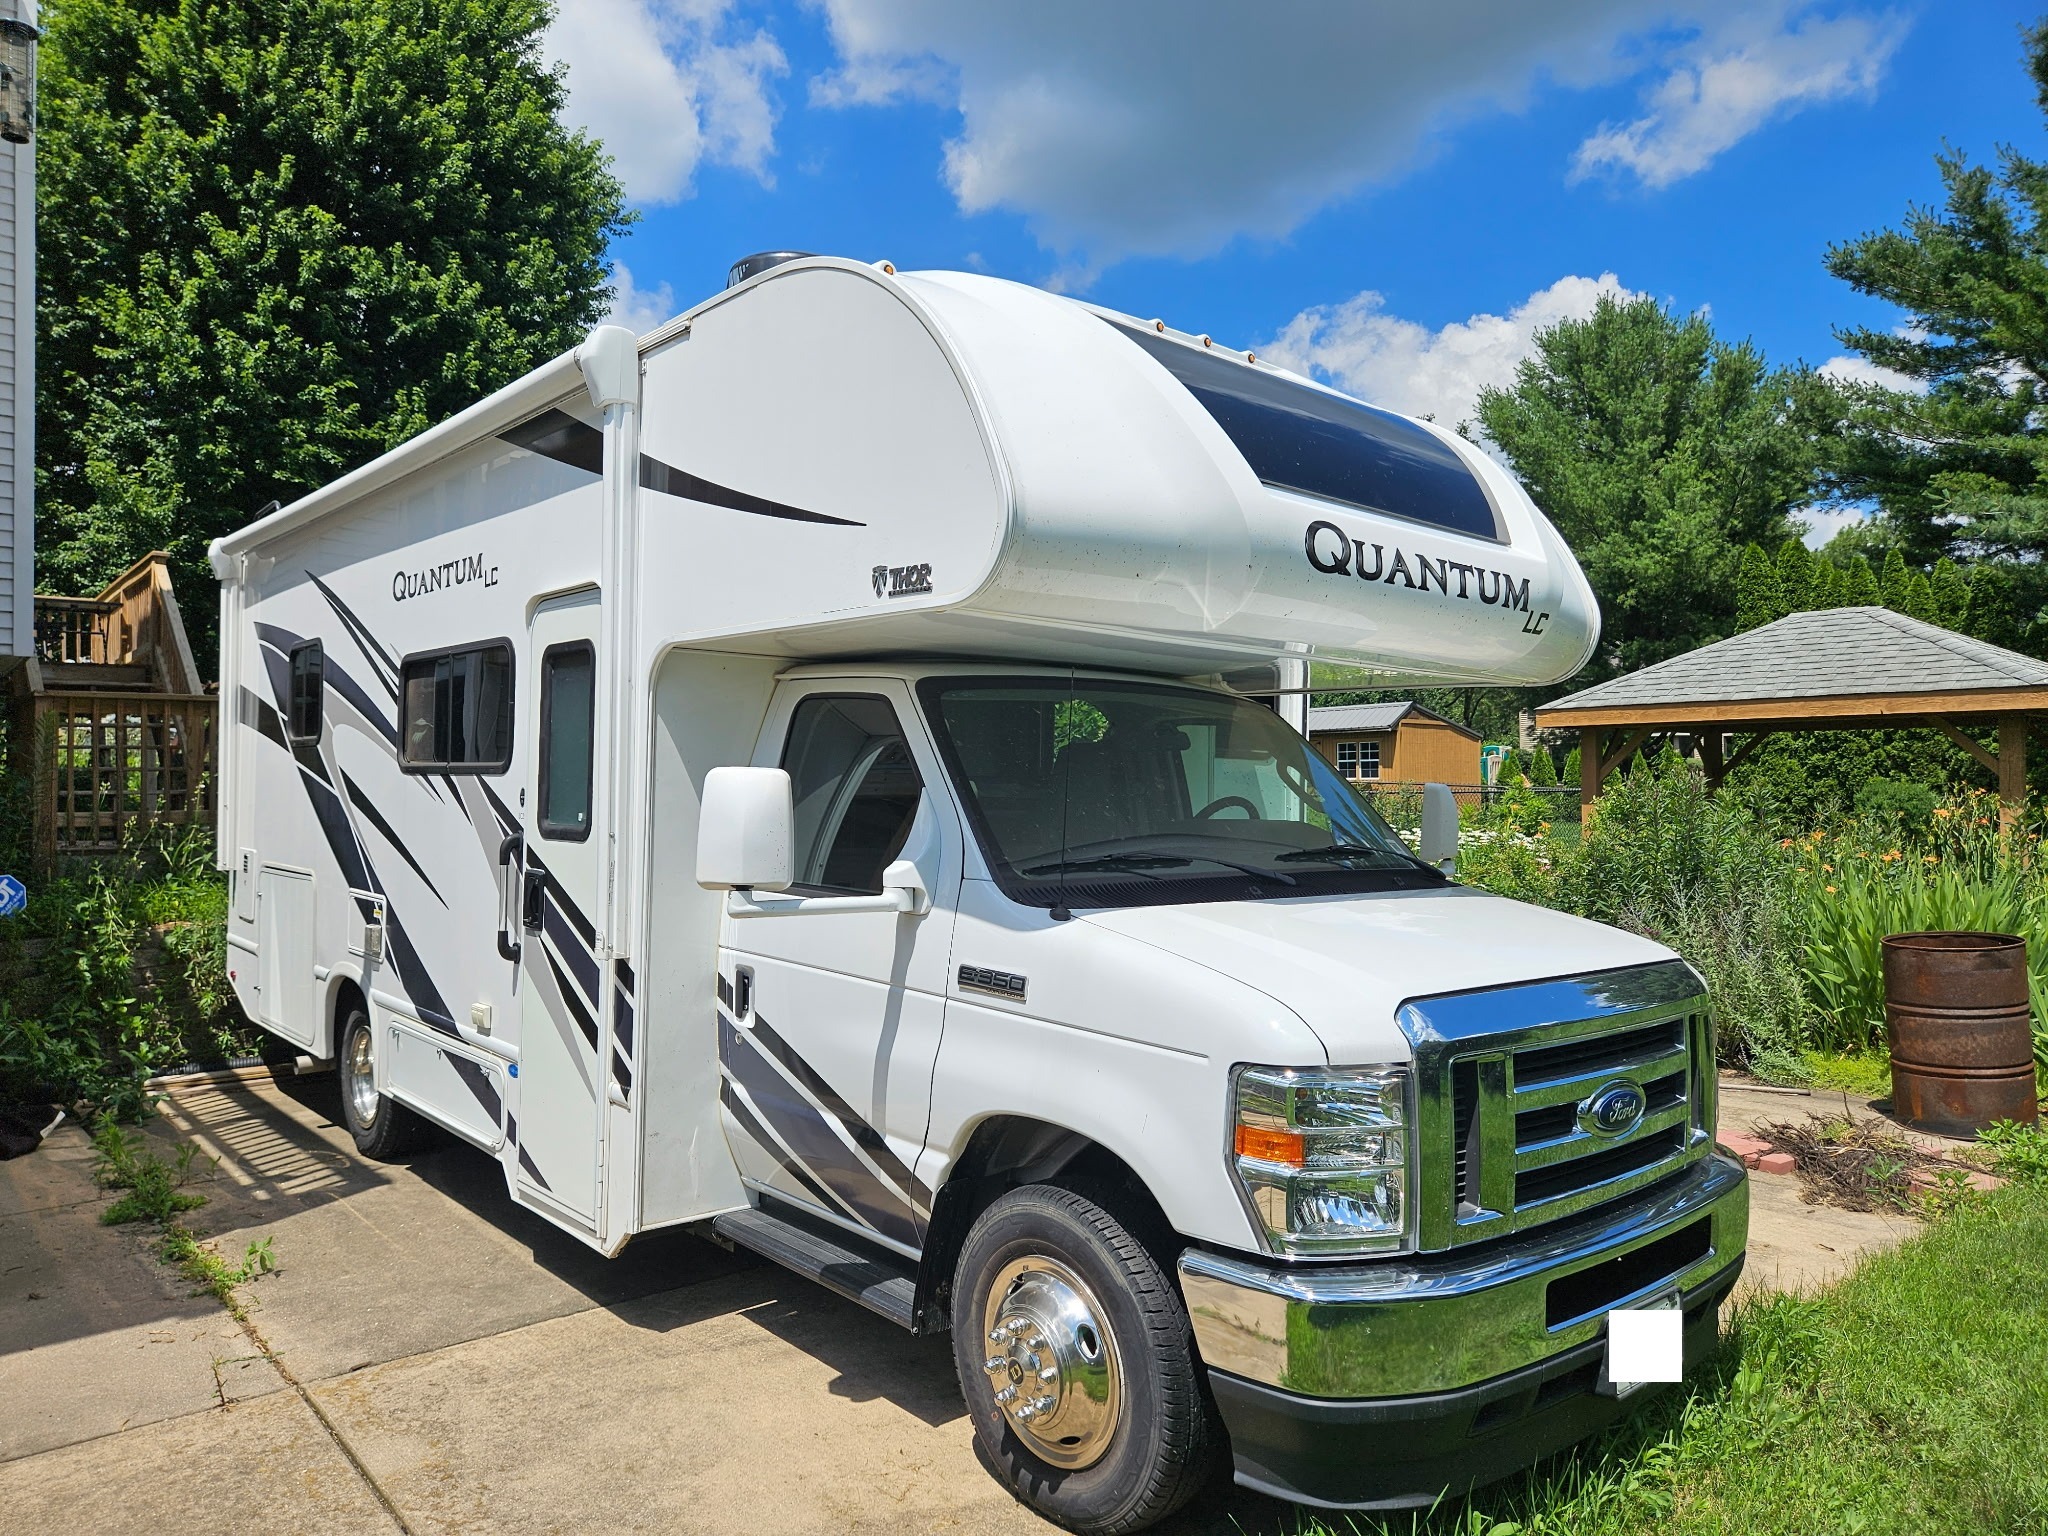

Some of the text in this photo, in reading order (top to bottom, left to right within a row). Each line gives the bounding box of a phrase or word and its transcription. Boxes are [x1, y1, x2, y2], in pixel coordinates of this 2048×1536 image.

[393, 553, 498, 601] QUANTUM LC
[889, 563, 932, 589] THOR
[1305, 520, 1549, 635] QUANTUM LC
[1610, 1096, 1636, 1123] Ford
